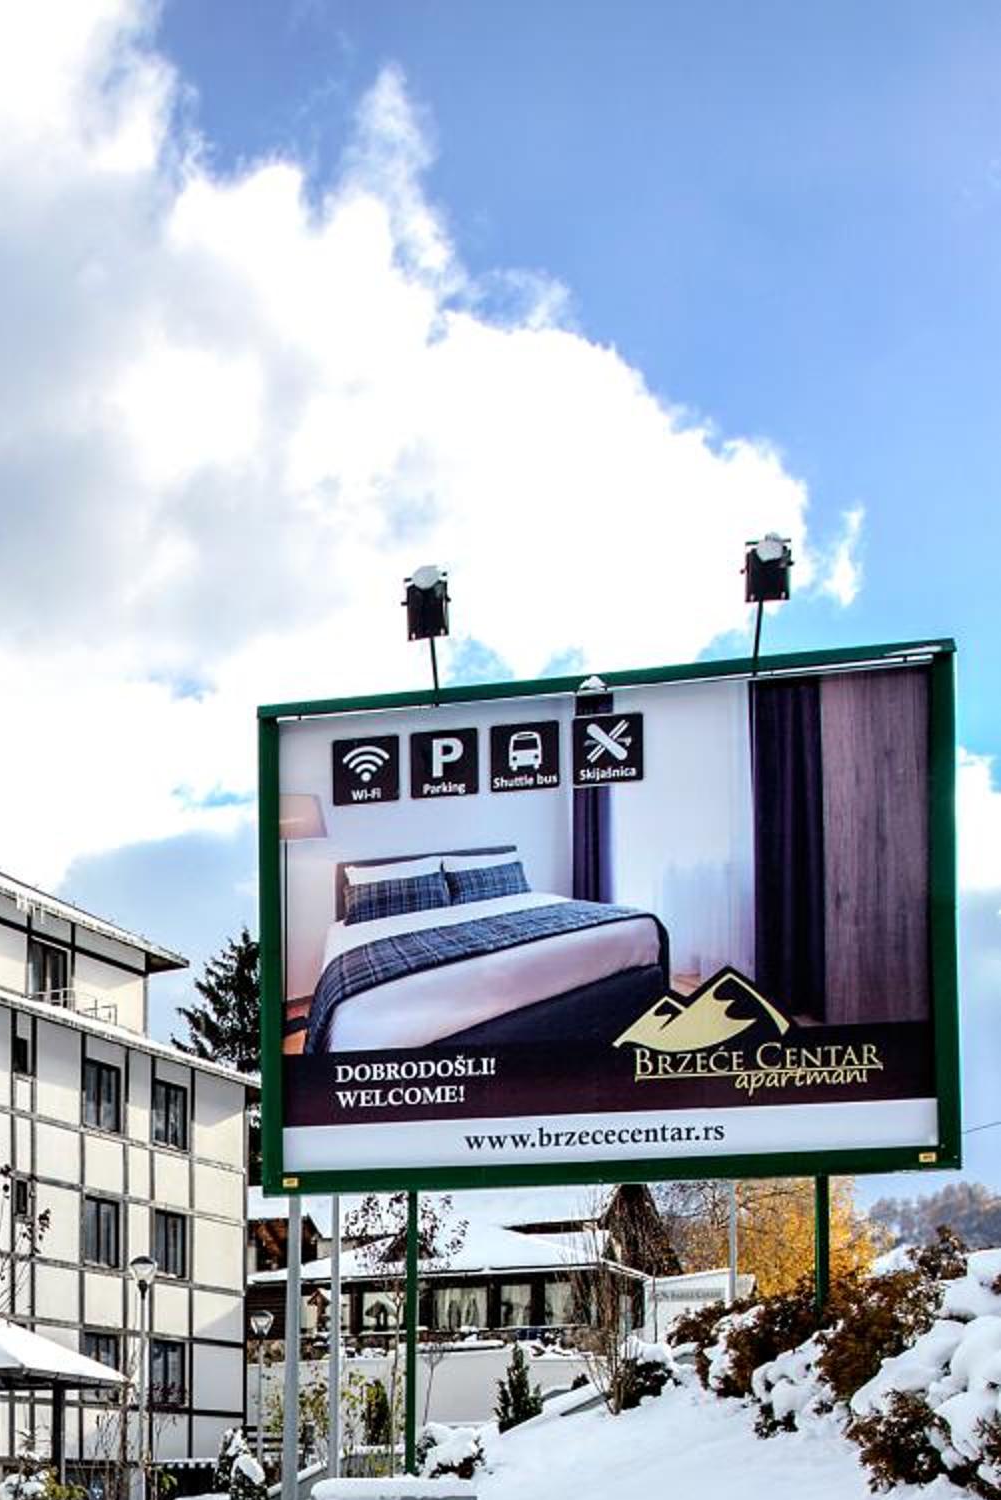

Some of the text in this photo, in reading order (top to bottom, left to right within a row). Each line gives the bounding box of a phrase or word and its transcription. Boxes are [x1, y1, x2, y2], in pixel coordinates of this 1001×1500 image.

[432, 737, 464, 778] P
[422, 781, 466, 795] Parking
[493, 773, 558, 789] Shuttle bus
[335, 1055, 496, 1083] DOBRODOŠLI!
[756, 1042, 881, 1071] CENTAR
[734, 1066, 868, 1096] apartmani
[335, 1085, 465, 1109] WELCOME!
[464, 1125, 726, 1150] www.brzececentar.rs
